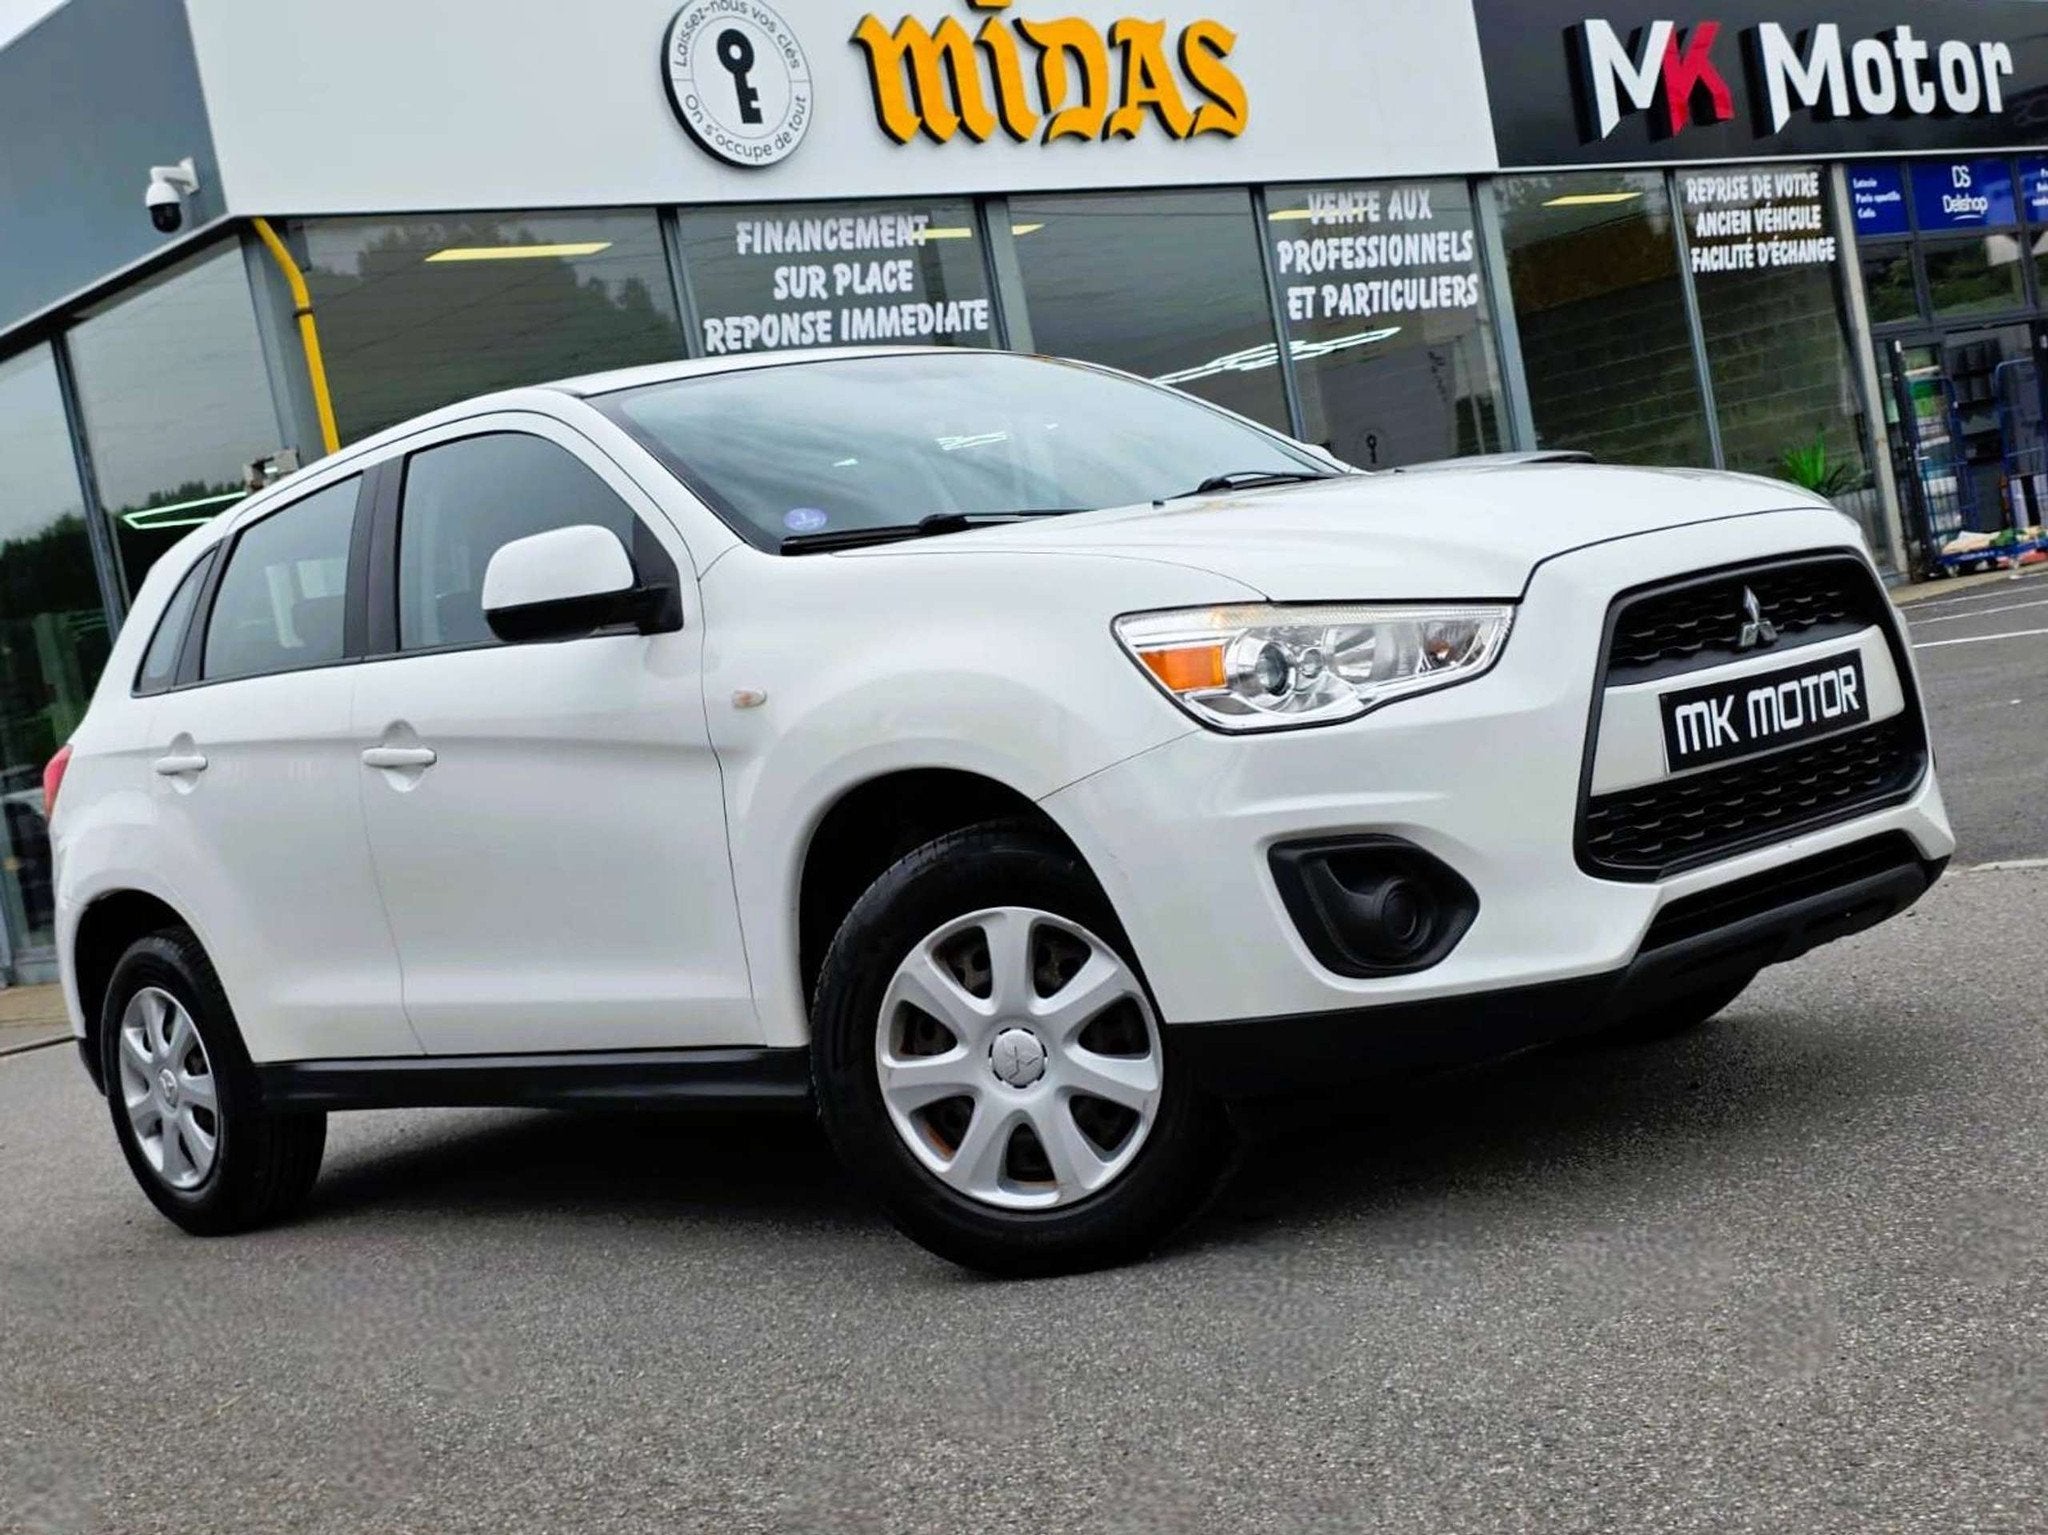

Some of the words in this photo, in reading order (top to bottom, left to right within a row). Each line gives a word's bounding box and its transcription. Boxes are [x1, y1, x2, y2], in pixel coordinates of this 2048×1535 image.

[673, 0, 749, 67] Laissez-nous
[752, 7, 777, 33] vos
[1583, 18, 1735, 140] MK
[1757, 22, 2014, 134] Motor
[685, 94, 704, 124] On
[704, 124, 772, 161] s'occupe
[774, 131, 793, 150] de
[788, 95, 806, 131] tout
[1686, 175, 1749, 204] REPRISE
[1752, 174, 1773, 200] DE
[1774, 172, 1819, 198] VOTRE
[1951, 164, 1972, 188] DS
[1308, 190, 1381, 225] VENTE
[1388, 188, 1433, 221] AUX
[1696, 208, 1752, 238] ANCIEN
[1753, 201, 1822, 233] VÉHICULE
[735, 214, 929, 255] FINANCEMENT
[1276, 229, 1474, 275] PROFESSIONNELS
[1690, 236, 1754, 273] FACILITÉ
[1756, 234, 1836, 267] D'ÉCHANGE
[773, 265, 828, 300] SUR
[832, 259, 914, 297] PLACE
[1287, 286, 1316, 321] ET
[1320, 273, 1479, 318] PARTICULIERS
[703, 310, 833, 354] REPONSE
[840, 299, 989, 341] IMMEDIATE
[1675, 695, 1740, 755] MK
[1746, 665, 1860, 739] MOTOR
